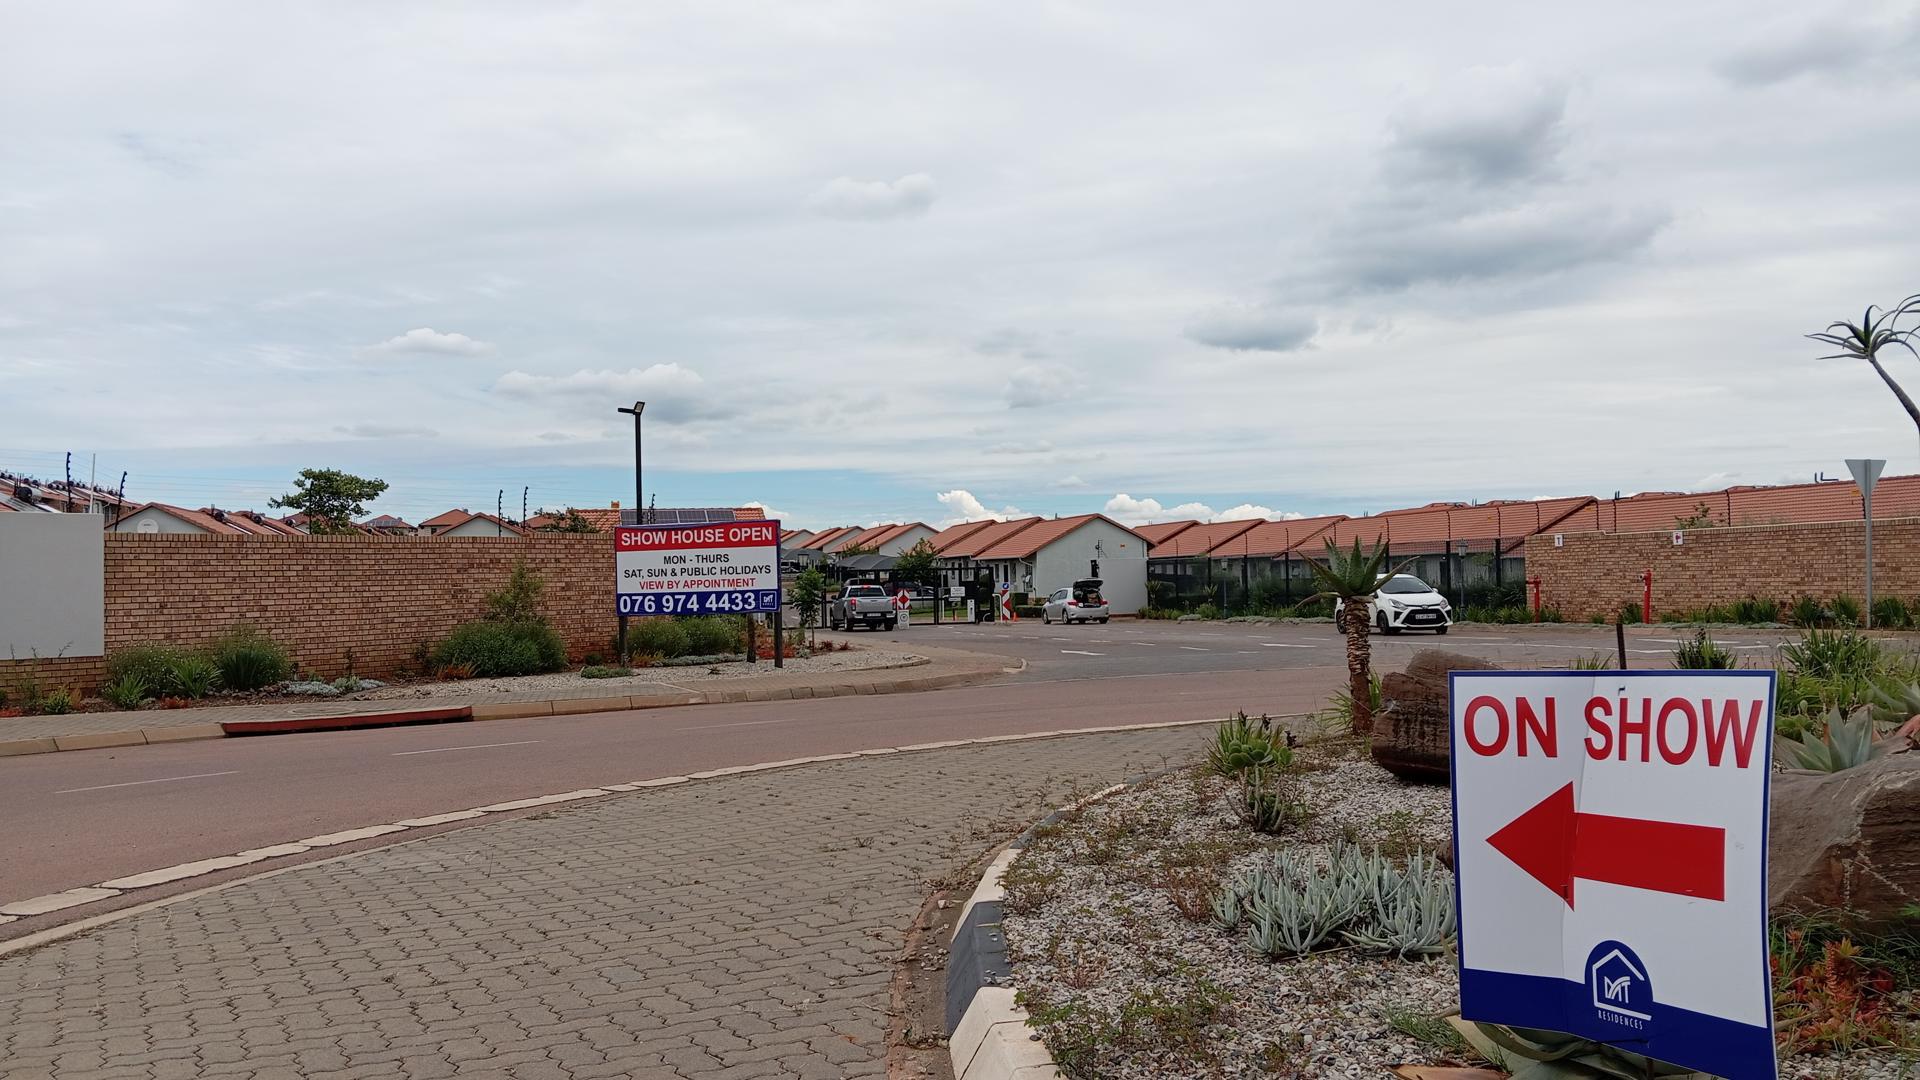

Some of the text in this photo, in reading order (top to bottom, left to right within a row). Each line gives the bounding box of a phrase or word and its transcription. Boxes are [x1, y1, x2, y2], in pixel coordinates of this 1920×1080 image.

[621, 527, 772, 546] SHOW HOUSE OPEN
[663, 555, 686, 565] MON
[695, 553, 730, 563] THURS
[623, 565, 771, 579] SAT, SUN & PUBLIC HOLIDAYS
[639, 578, 756, 590] VIEW BY APPOINTMENT
[620, 592, 756, 613] 076 974 4433
[1463, 695, 1764, 769] ON SHOW
[1598, 1009, 1643, 1030] RESIDENCES
